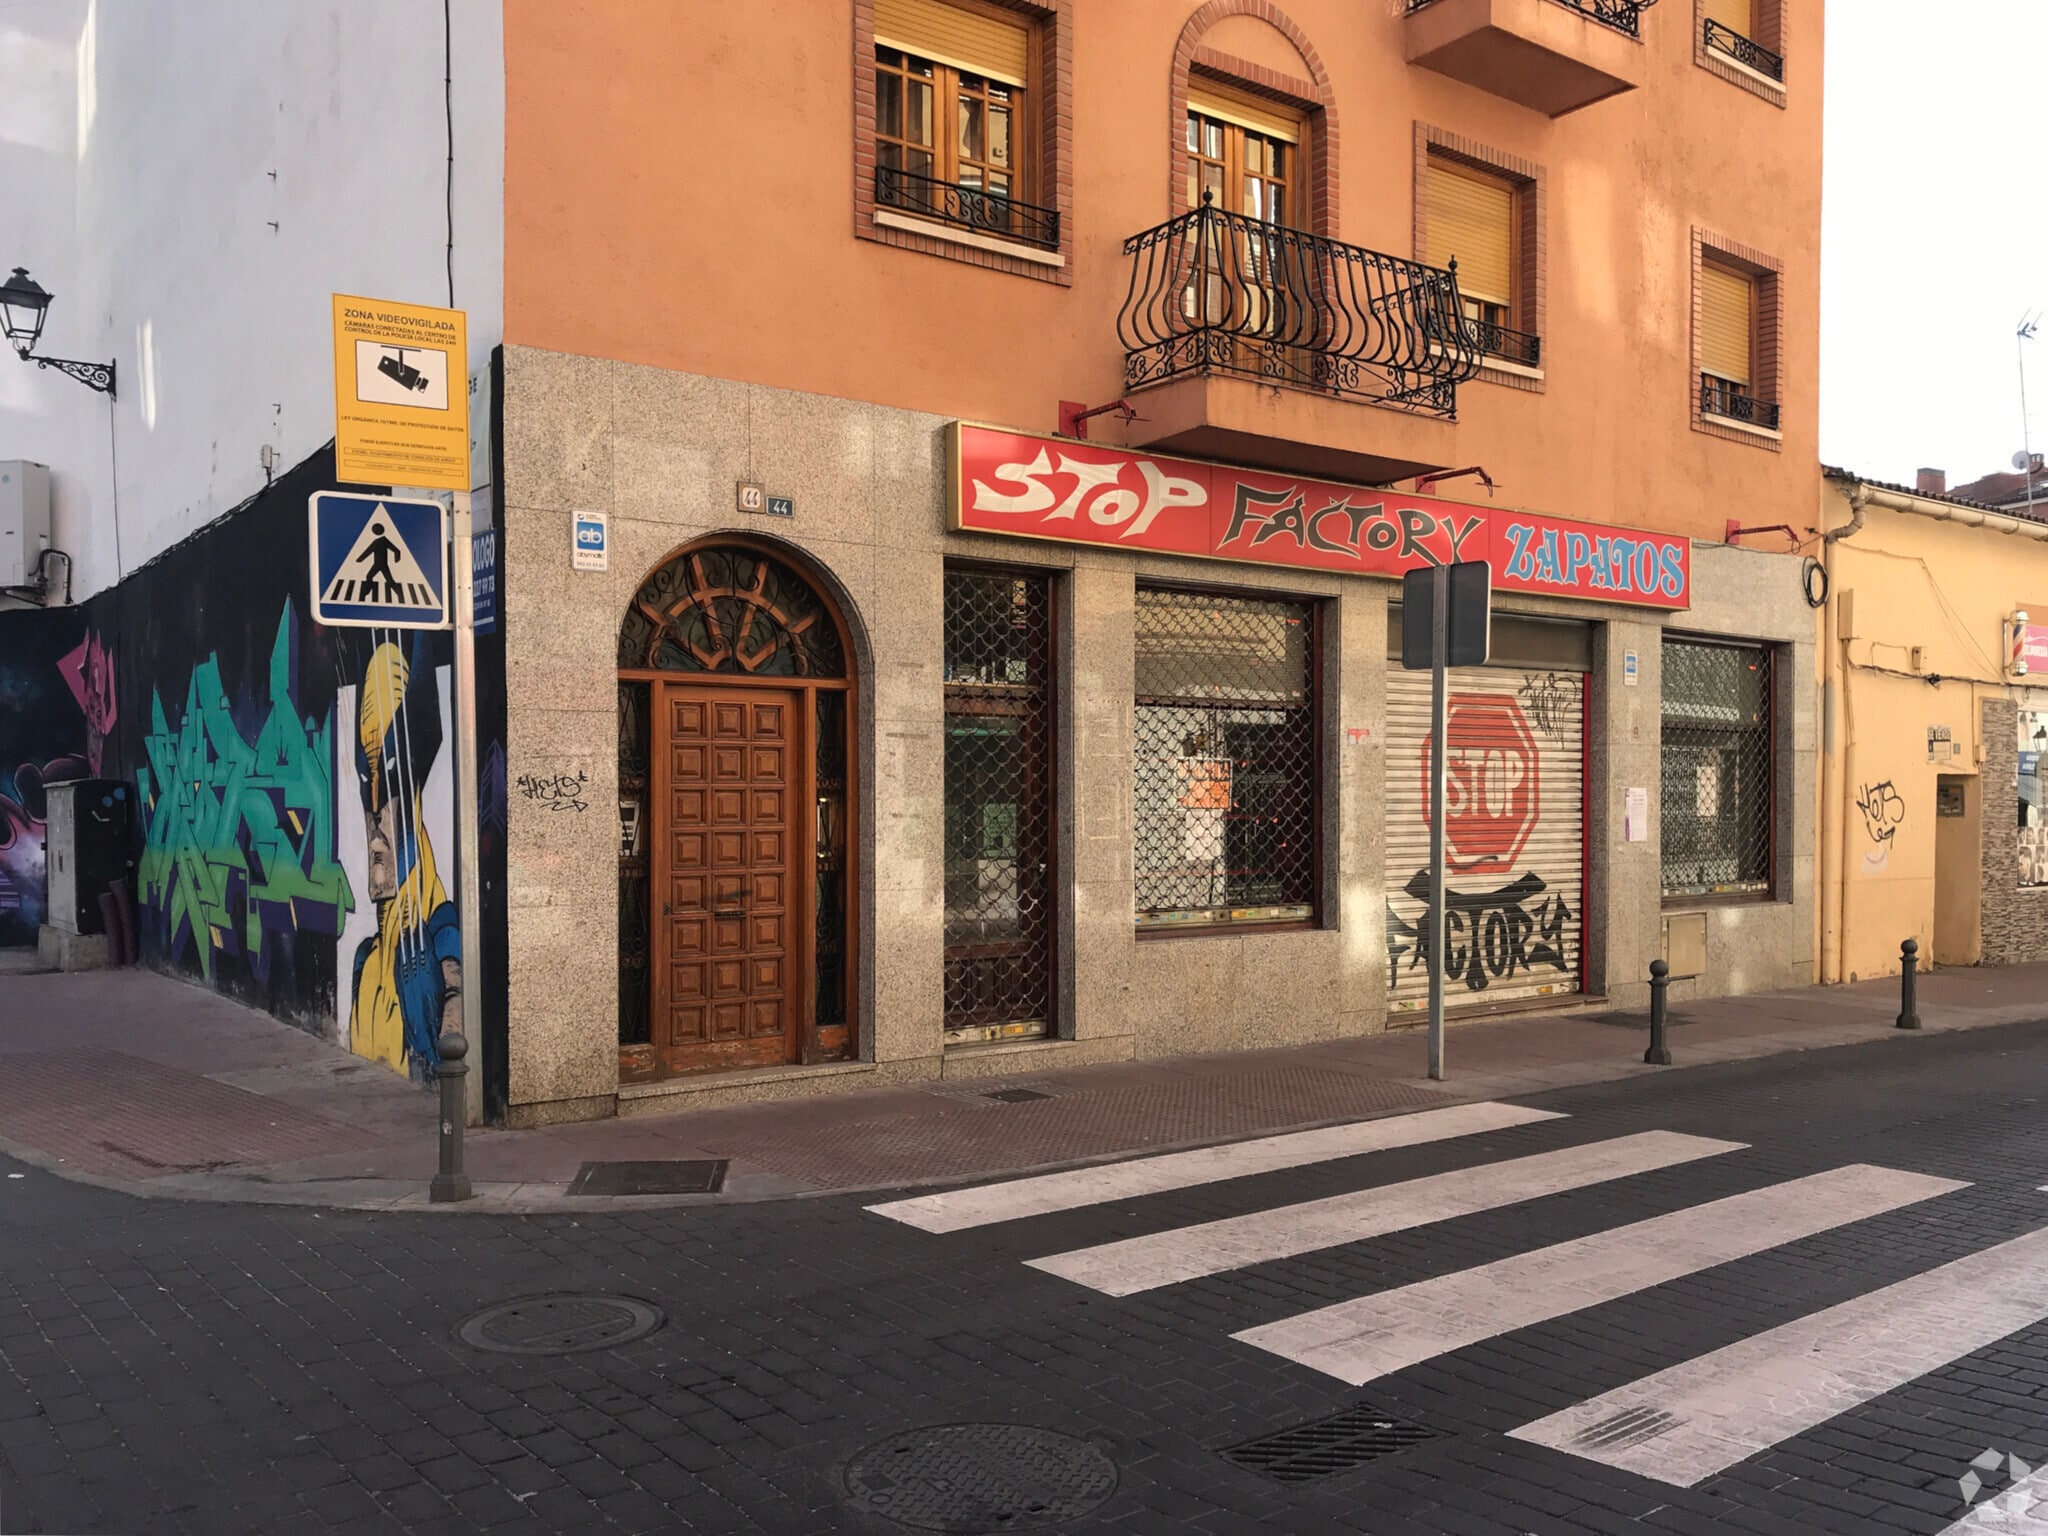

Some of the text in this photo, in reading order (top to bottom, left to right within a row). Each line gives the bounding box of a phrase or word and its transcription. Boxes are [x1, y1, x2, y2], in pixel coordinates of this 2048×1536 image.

[344, 308, 456, 331] ZONA VIDEOVIGILADA
[344, 320, 374, 329] CÁMARAS
[375, 324, 415, 335] CONECTADAS
[424, 330, 448, 339] CENTRO
[344, 326, 373, 335] CONTROL
[414, 335, 432, 343] LOCAL
[745, 490, 759, 506] 44
[773, 500, 788, 515] 44
[972, 446, 1683, 598] STOP FACTORY ZAPATOS
[579, 527, 602, 544] ab
[1446, 749, 1525, 818] STOP
